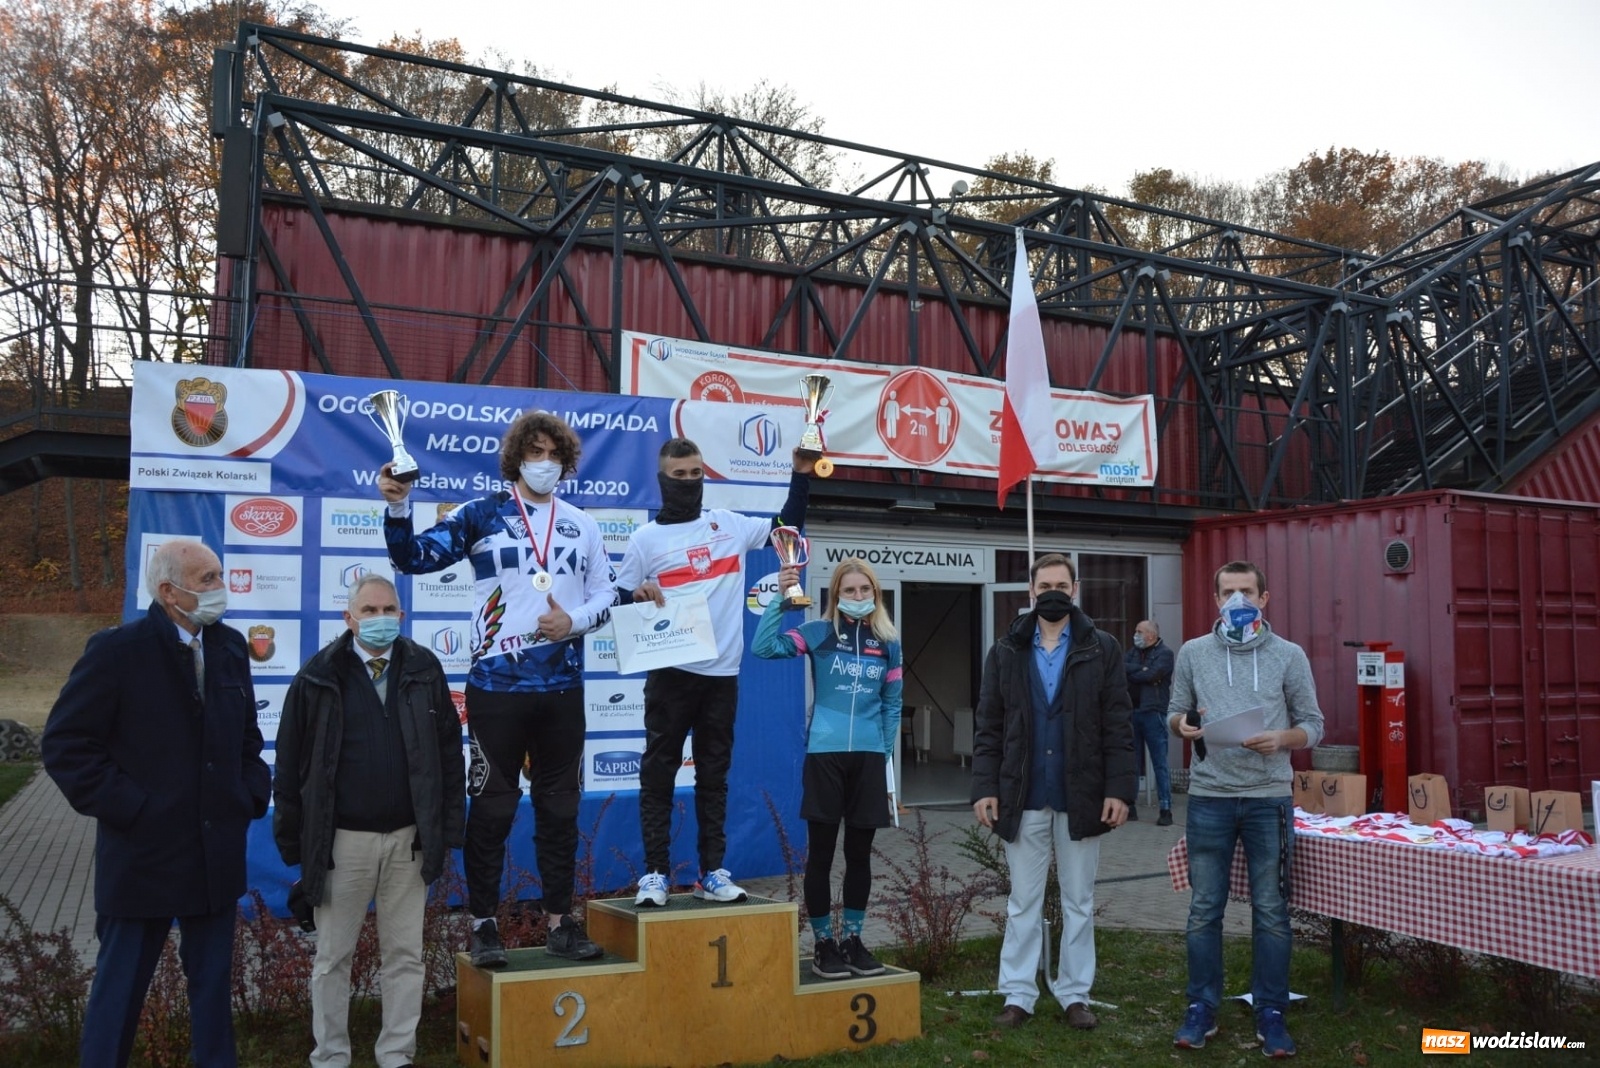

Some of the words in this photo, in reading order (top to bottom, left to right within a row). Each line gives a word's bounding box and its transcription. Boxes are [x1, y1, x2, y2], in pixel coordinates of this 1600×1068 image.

[699, 373, 736, 391] KORONA
[910, 419, 928, 436] 2m
[729, 459, 771, 468] WODZISŁAW
[772, 461, 793, 470] ŚLĄSK
[1100, 464, 1140, 477] mosir
[138, 467, 169, 477] Polski
[172, 468, 213, 480] Związek
[216, 470, 257, 481] Kolarski
[1105, 475, 1136, 485] centrum
[337, 526, 379, 536] centrum
[825, 546, 975, 567] WYPOŻYCZALNIA
[256, 574, 297, 582] Ministerstwo
[256, 583, 279, 591] Sportu
[418, 582, 474, 592] Timemaste
[759, 583, 779, 593] UC
[633, 626, 696, 643] Timemaster
[590, 702, 646, 712] Timemaster
[708, 935, 734, 989] 1
[553, 990, 590, 1048] 2
[848, 992, 878, 1044] 3
